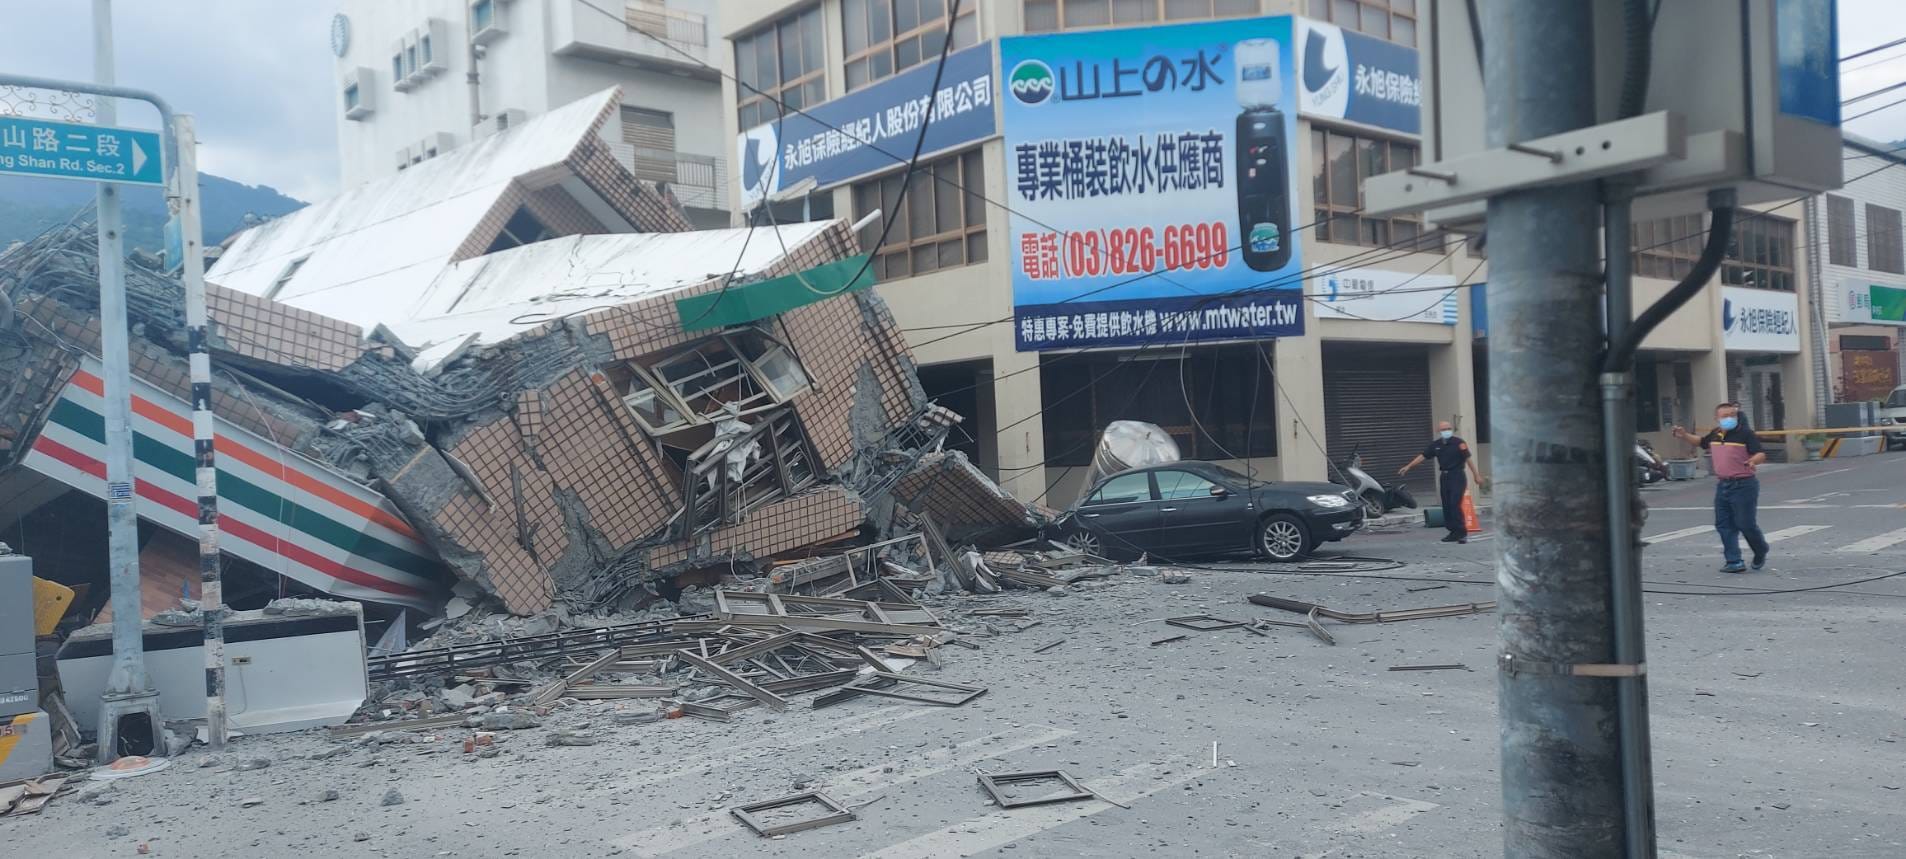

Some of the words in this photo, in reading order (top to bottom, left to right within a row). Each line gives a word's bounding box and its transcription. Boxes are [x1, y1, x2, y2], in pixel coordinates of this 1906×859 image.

[1060, 50, 1224, 102] 山上の水
[3, 125, 121, 157] 山路二段
[784, 75, 991, 170] 永旭保險經紀人股份有限公司
[18, 154, 56, 169] Shan
[60, 158, 83, 171] Rd.
[87, 160, 125, 175] Sec.2
[1015, 130, 1224, 201] 專業桶裝飲水供應商
[1021, 232, 1060, 280] 電話
[1062, 222, 1229, 278] (03)826-6699
[1159, 300, 1297, 333] www.mtwater.tw
[1740, 307, 1798, 335] 永旭保險經紀人
